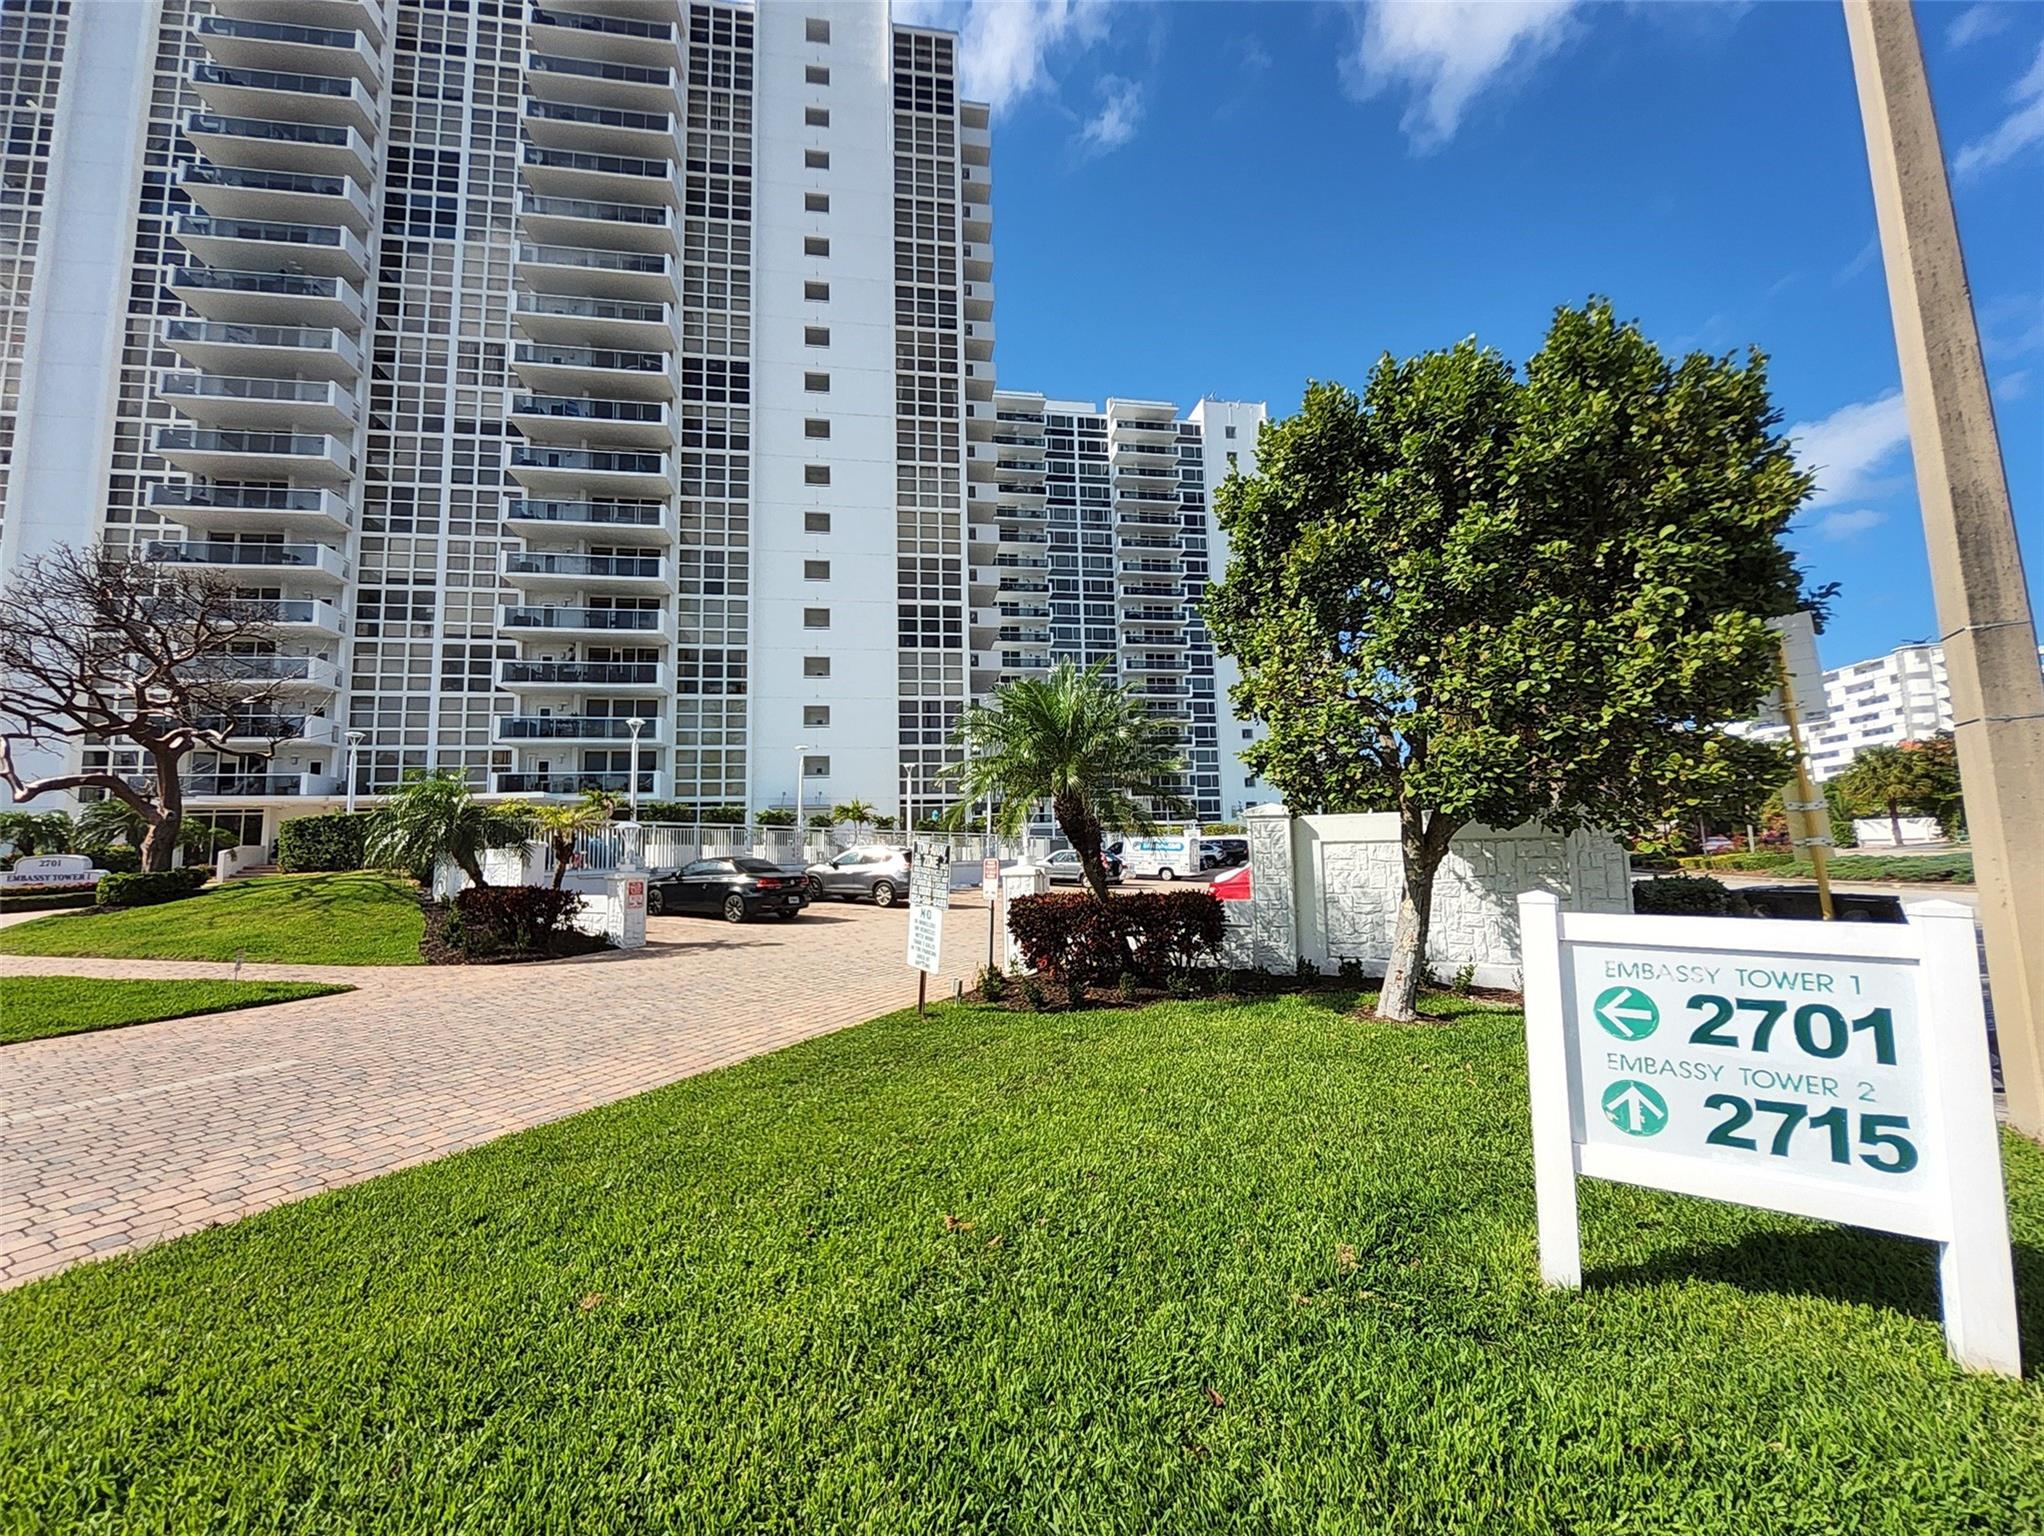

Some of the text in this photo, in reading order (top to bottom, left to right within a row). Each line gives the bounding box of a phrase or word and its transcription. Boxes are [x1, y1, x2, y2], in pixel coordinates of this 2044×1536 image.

[53, 873, 85, 881] TOWER
[1605, 960, 1861, 995] EMBASSY TOWER 1
[1686, 993, 1897, 1066] 2701
[1607, 1053, 1876, 1102] EMBASSY TOWER 2
[1703, 1093, 1919, 1174] 2715
